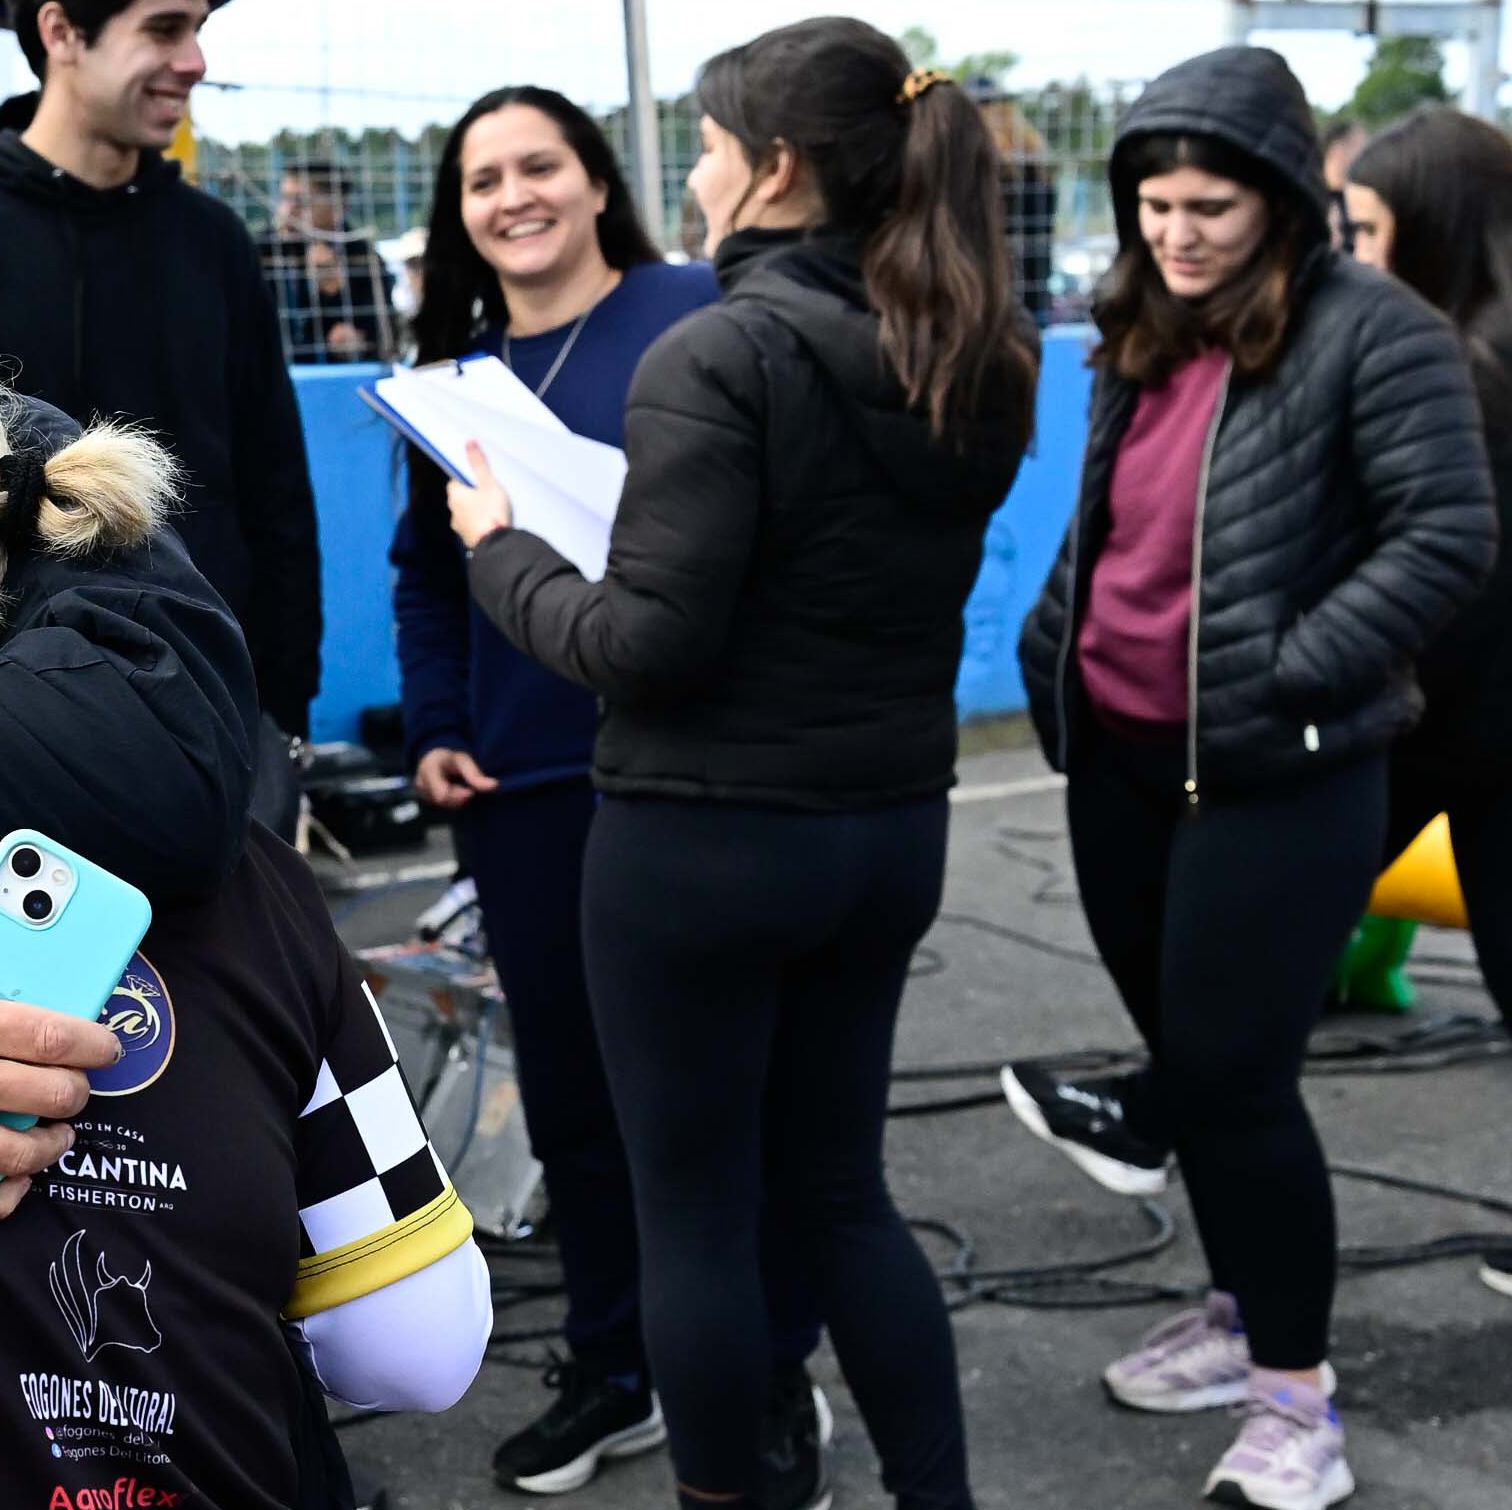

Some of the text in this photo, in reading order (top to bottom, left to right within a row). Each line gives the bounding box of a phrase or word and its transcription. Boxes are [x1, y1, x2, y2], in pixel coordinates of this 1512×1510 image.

[97, 1123, 112, 1132] EN
[116, 1126, 145, 1143] CASA
[58, 1150, 188, 1191] CANTINA
[49, 1184, 156, 1211] FISHERTON
[19, 1372, 92, 1420] FOGONES
